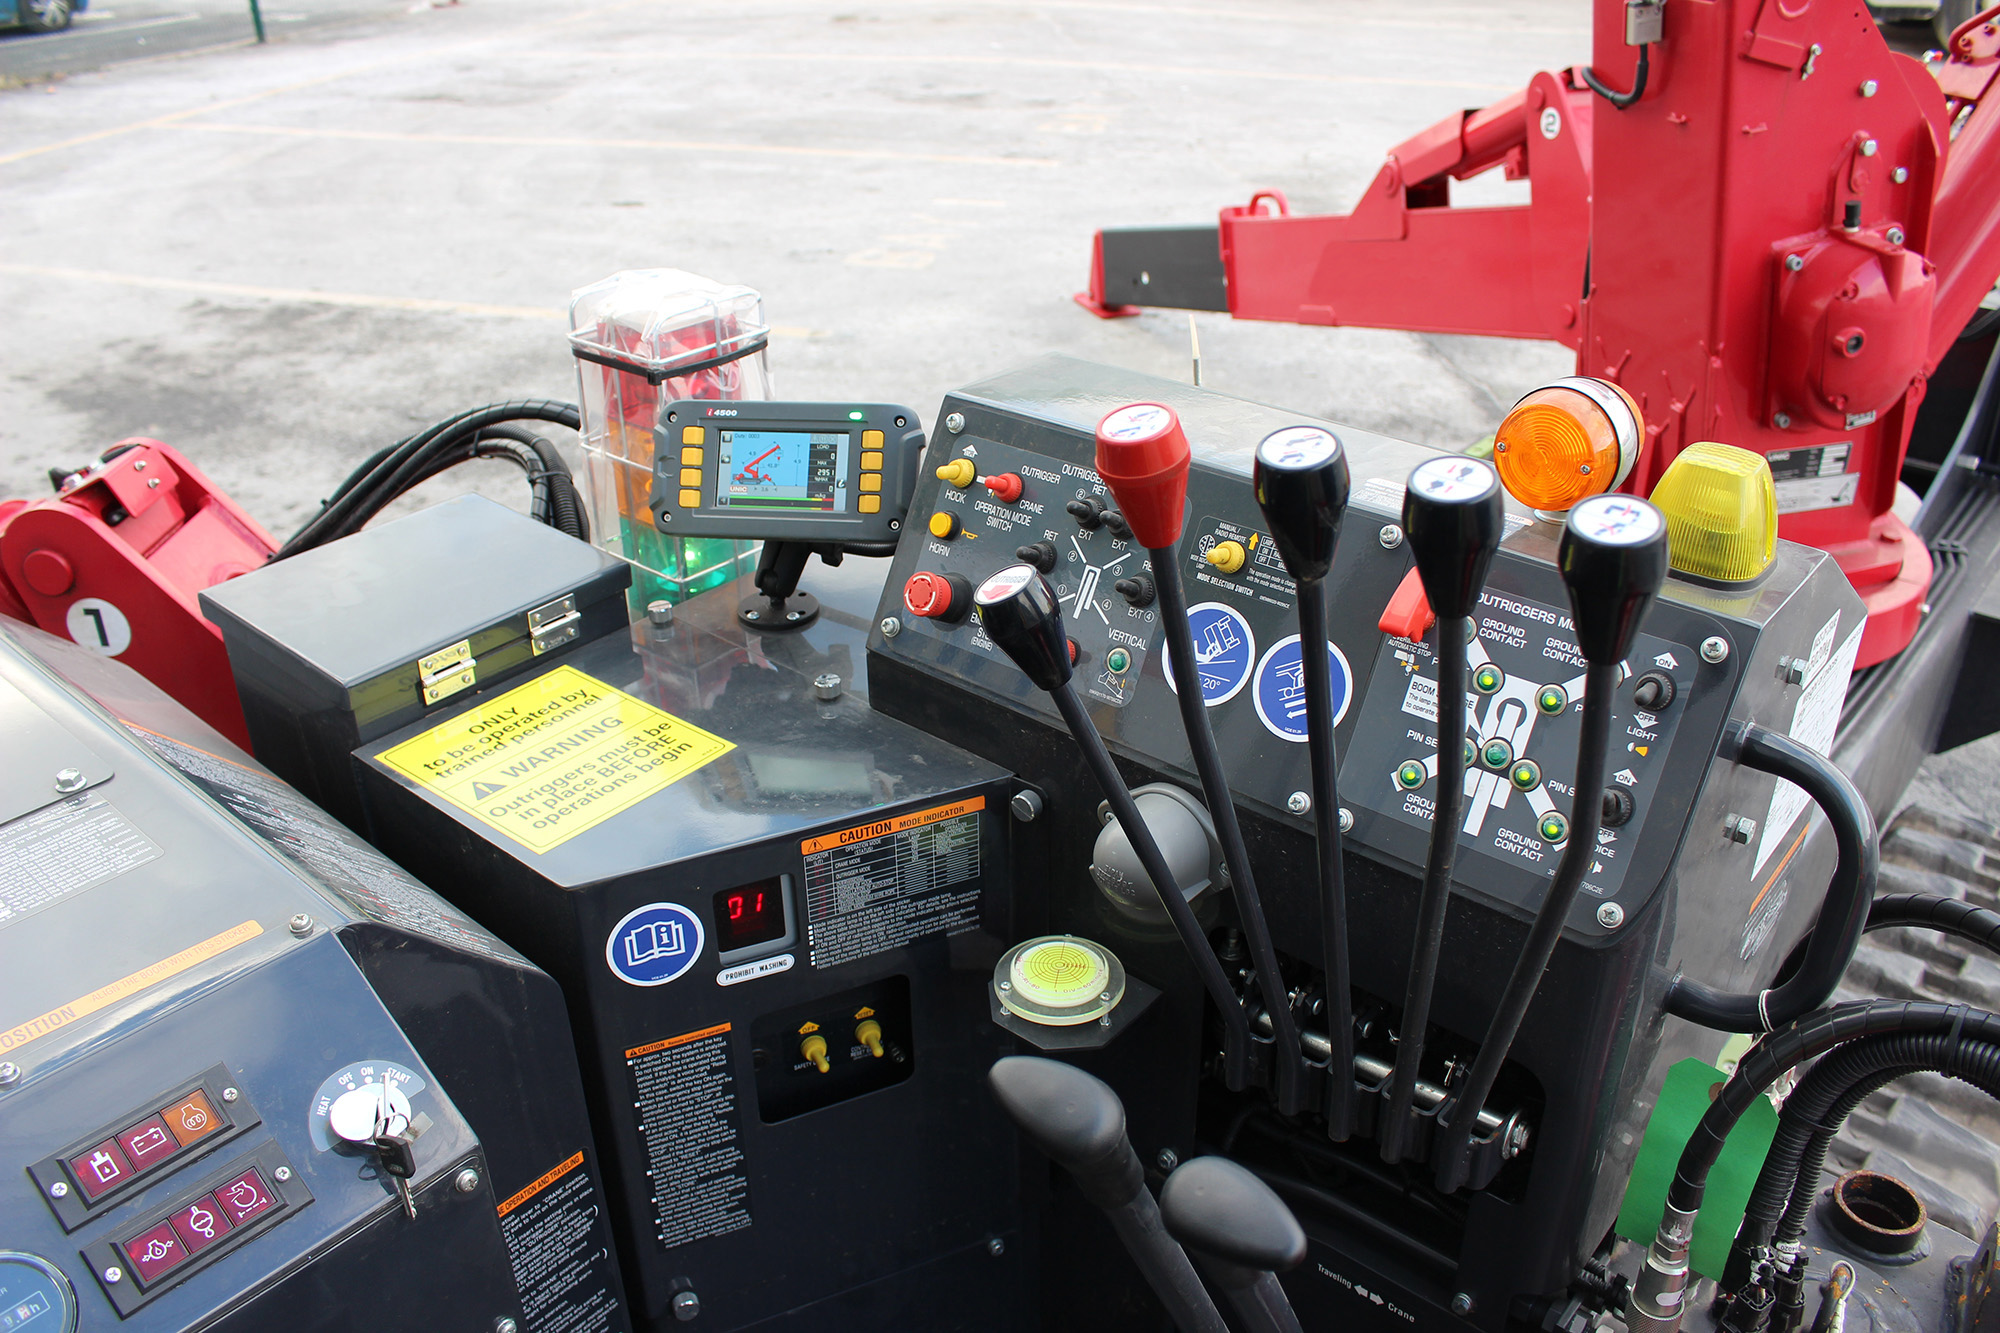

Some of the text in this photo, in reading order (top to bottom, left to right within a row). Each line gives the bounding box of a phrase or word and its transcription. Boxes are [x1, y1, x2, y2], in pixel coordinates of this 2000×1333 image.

[1545, 112, 1556, 132] 2
[1021, 465, 1061, 485] OUTRIGGER
[944, 488, 967, 504] HOOK
[1091, 484, 1108, 496] RET
[974, 500, 1033, 527] OPERATION MODE
[1019, 499, 1045, 515] CRANE
[985, 515, 1014, 533] SWITCH
[1219, 521, 1237, 533] MANUAL
[1043, 529, 1059, 542] RET
[1078, 528, 1094, 541] EXT
[1214, 528, 1247, 544] RADIO REMOTE
[928, 541, 951, 557] HORN
[1111, 539, 1128, 551] EXT
[1142, 559, 1153, 572] RE
[1196, 572, 1254, 597] MODE SELECTION SWITCH
[1127, 606, 1144, 621] EXT
[83, 608, 109, 647] 1
[1482, 617, 1526, 637] GROUND
[970, 636, 993, 652] (ENGINE)
[1108, 627, 1147, 651] VERTICAL
[1478, 627, 1528, 649] CONTACT
[1387, 639, 1432, 658] AUTOMATIC STOP
[1542, 647, 1588, 669] CONTAC
[1658, 658, 1672, 668] ON
[1408, 692, 1418, 701] The
[1411, 681, 1436, 696] BOOM
[1412, 703, 1435, 716] operate
[1637, 713, 1654, 723] OFF
[423, 688, 589, 772] to be operated by
[468, 706, 519, 736] ONLY
[435, 693, 604, 780] trained personnel
[1406, 729, 1424, 743] PIN
[1626, 725, 1658, 742] LIGHT
[499, 715, 625, 779] WARNING
[489, 720, 673, 820] Outriggers must be
[515, 733, 678, 821] in place BEFORE
[1617, 774, 1632, 783] ON
[531, 740, 694, 830] operations begin
[1547, 779, 1568, 795] PIN
[839, 821, 892, 844] CAUTION
[899, 816, 922, 829] MODE
[923, 805, 965, 823] INDICATOR
[1497, 827, 1542, 851] GROUND
[1494, 837, 1544, 863] CONTACT
[727, 892, 764, 920] 01
[725, 958, 788, 981] PROHIBIT WASHING
[0, 924, 251, 1049] OSITION ALIGN THE BOOM WITH THIS STICKER
[637, 1027, 726, 1054] CAUTION Remote controlled operation
[672, 1044, 693, 1054] seconds
[338, 1071, 354, 1086] OFF
[360, 1066, 374, 1076] ON
[387, 1067, 412, 1084] START
[316, 1095, 331, 1117] HEAT
[505, 1183, 538, 1212] OPERATION
[537, 1175, 551, 1192] AND
[549, 1155, 581, 1183] TRAVELING
[1317, 1263, 1416, 1323] Traveling Crane
